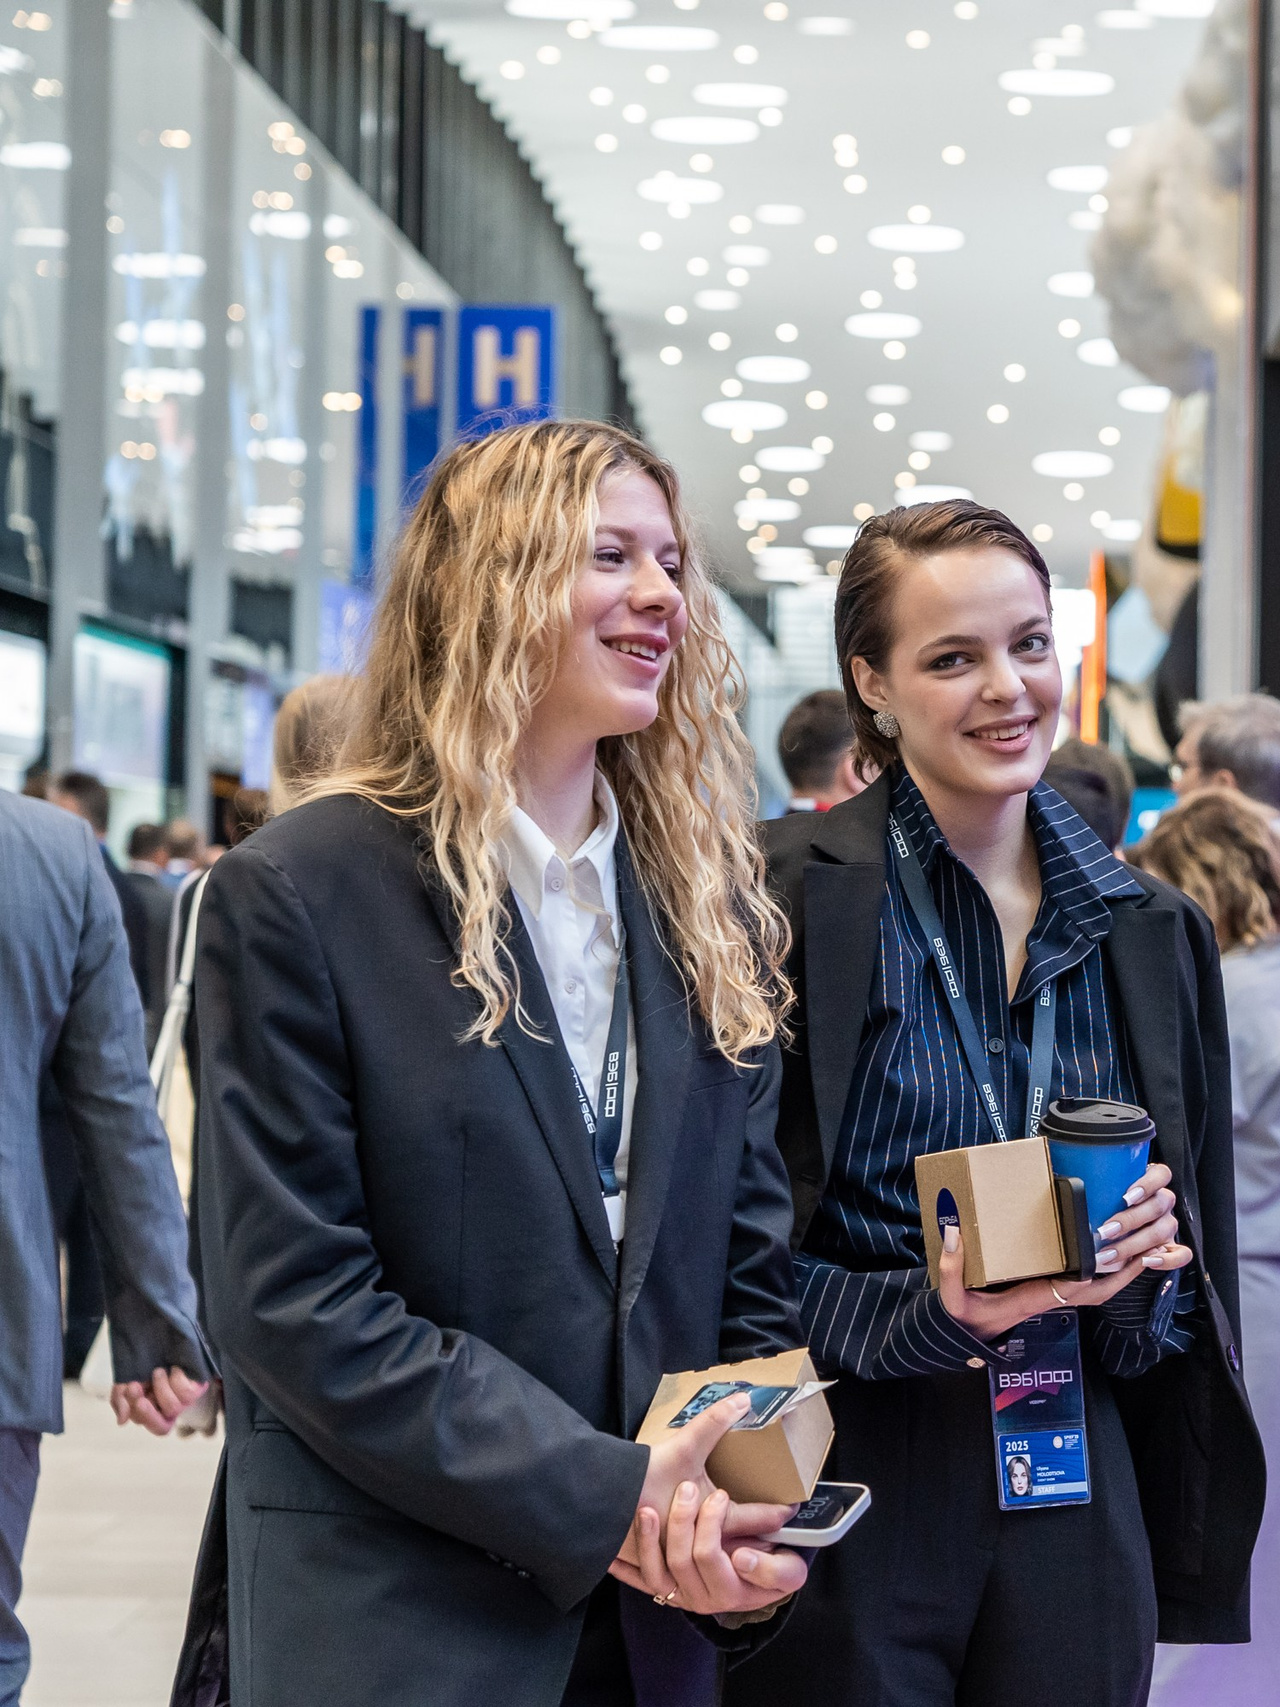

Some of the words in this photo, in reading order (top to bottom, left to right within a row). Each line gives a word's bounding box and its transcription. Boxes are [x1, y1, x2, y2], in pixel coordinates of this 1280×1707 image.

[474, 325, 540, 410] H
[933, 937, 960, 999] ВЭБ|РФ
[604, 1051, 619, 1117] ВЭБ|РФ
[998, 1370, 1073, 1388] ВЭБ|РФ
[1005, 1440, 1029, 1452] 2025
[1037, 1486, 1056, 1494] STAFF
[797, 1496, 830, 1519] 10:18
